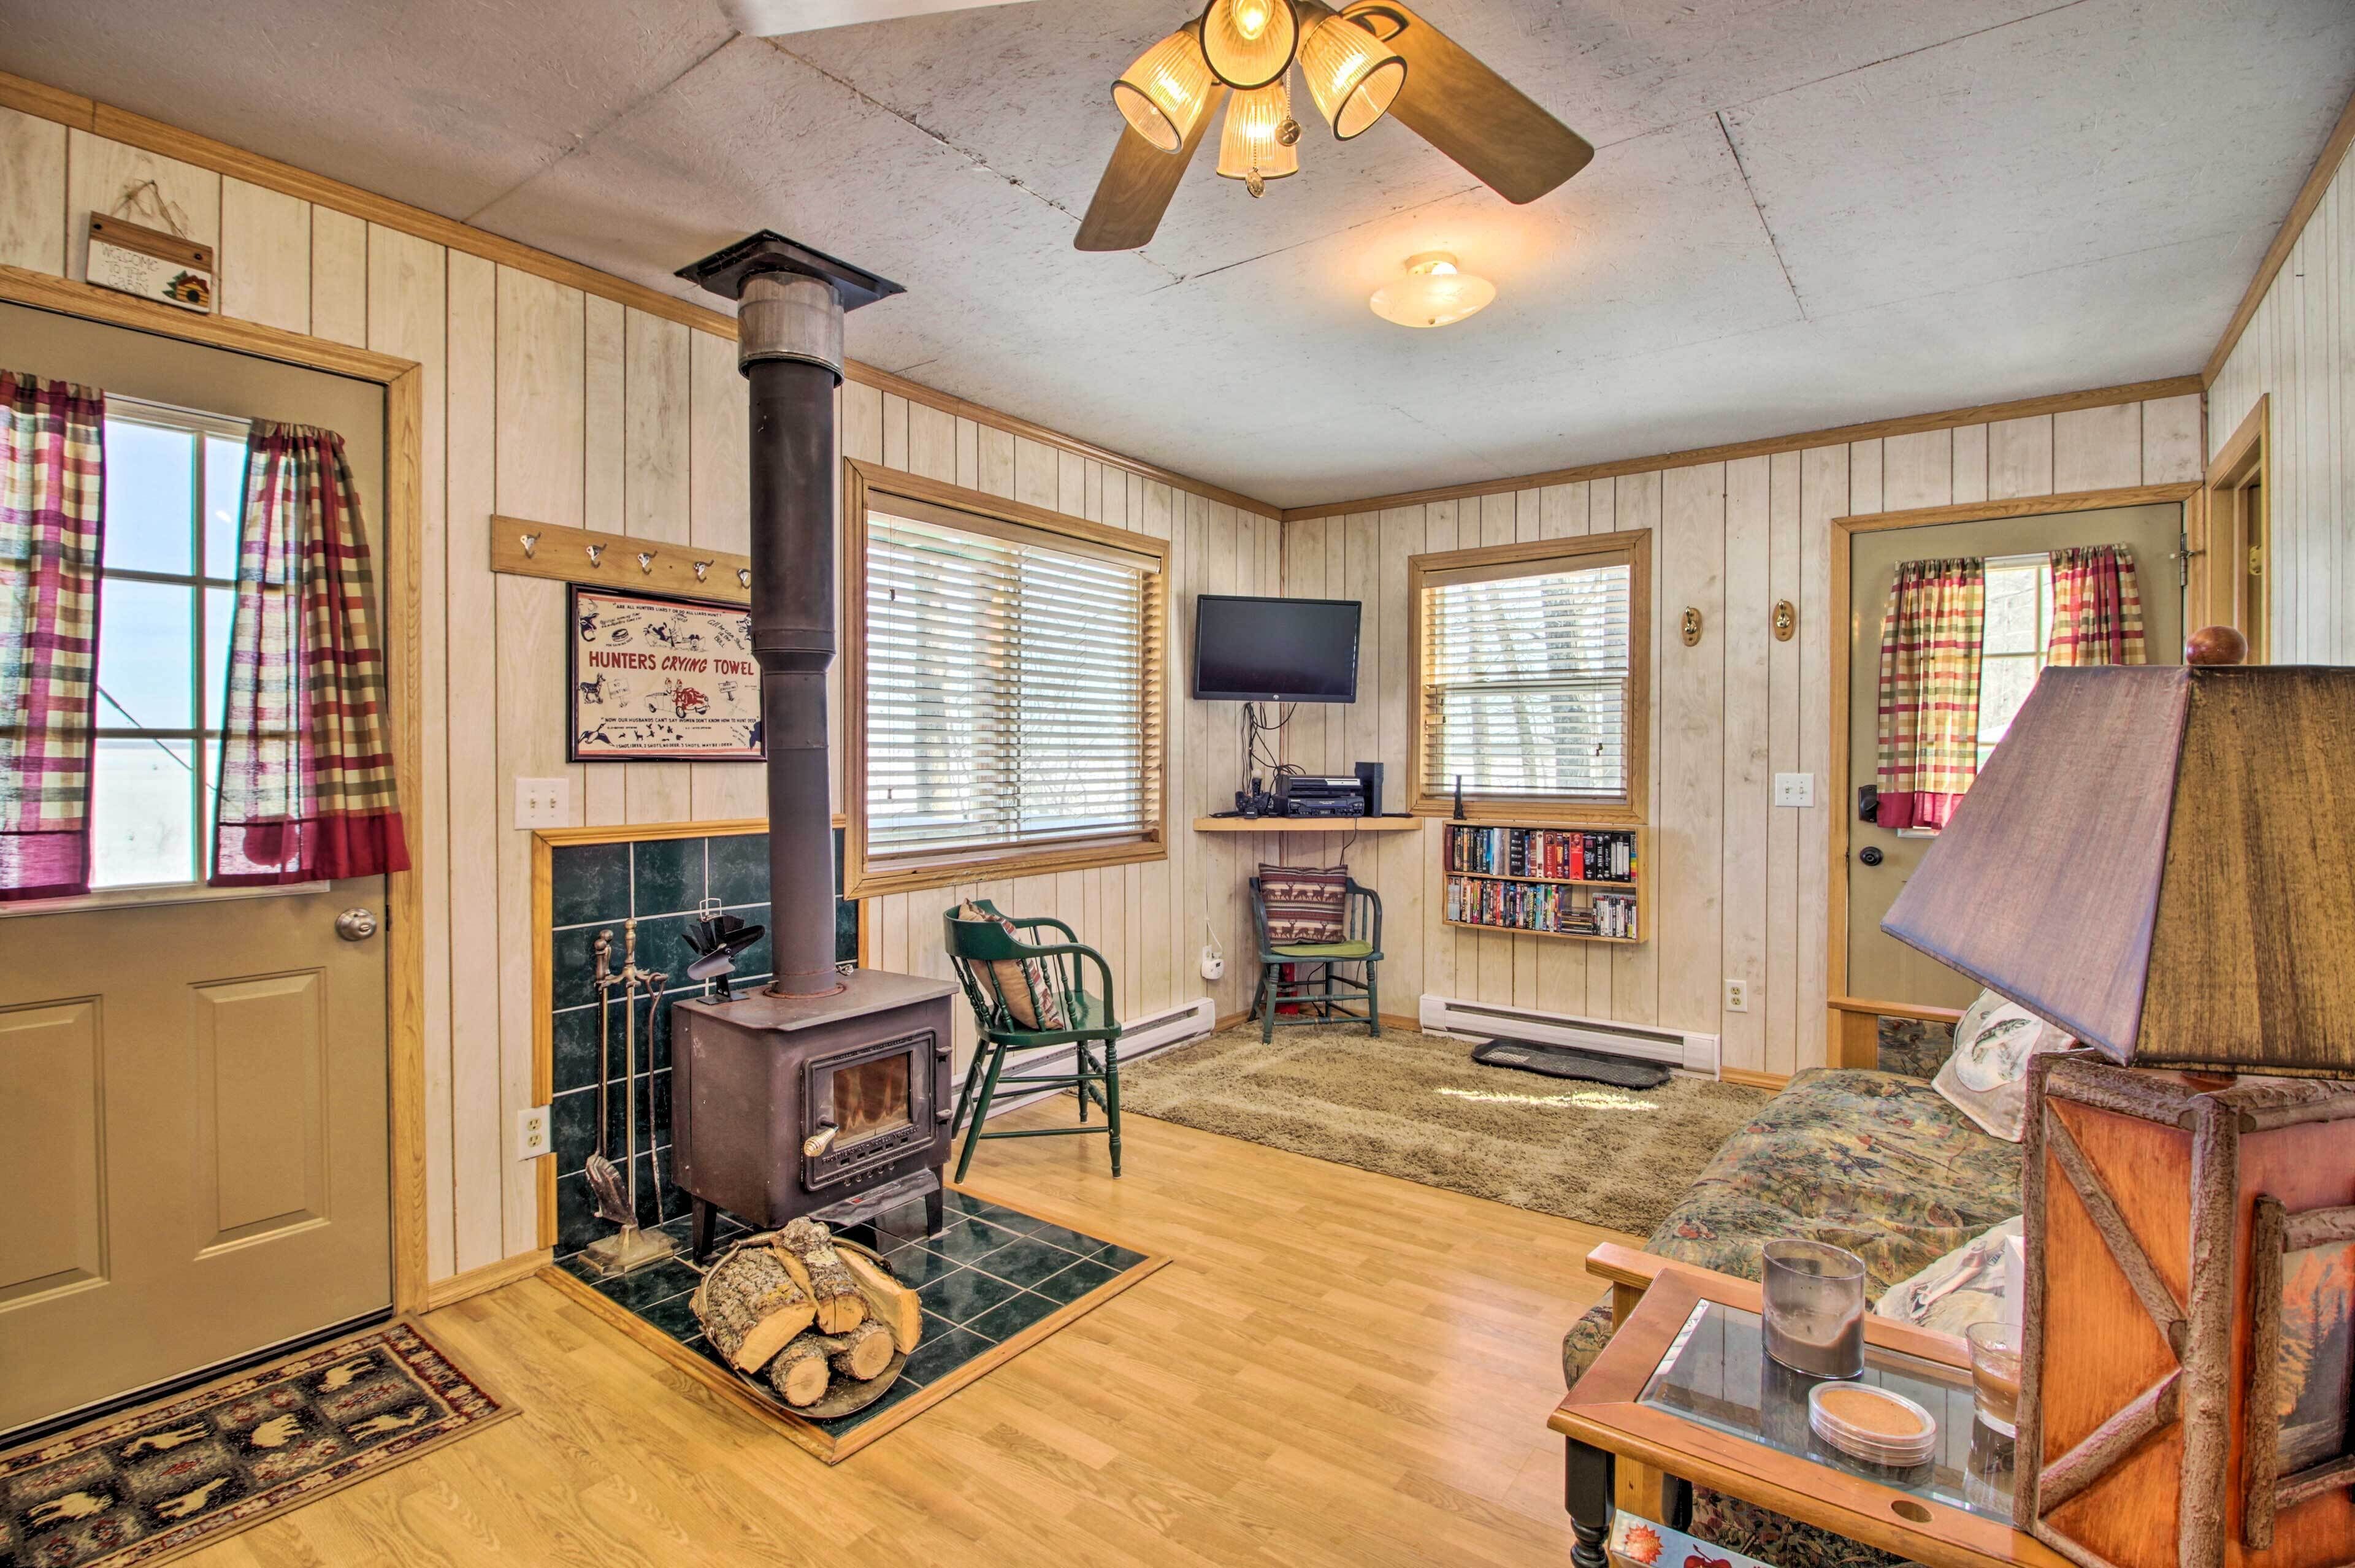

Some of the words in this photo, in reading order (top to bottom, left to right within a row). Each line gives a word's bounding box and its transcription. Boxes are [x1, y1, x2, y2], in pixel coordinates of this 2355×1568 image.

[102, 243, 159, 272] WELCOME
[104, 261, 120, 274] TO
[124, 266, 148, 281] THE
[714, 635, 726, 648] BULL
[589, 651, 656, 670] HUNTERS
[661, 655, 707, 673] CRYING
[713, 659, 754, 675] TOWEL
[822, 1144, 865, 1164] FRONTIERSMAN
